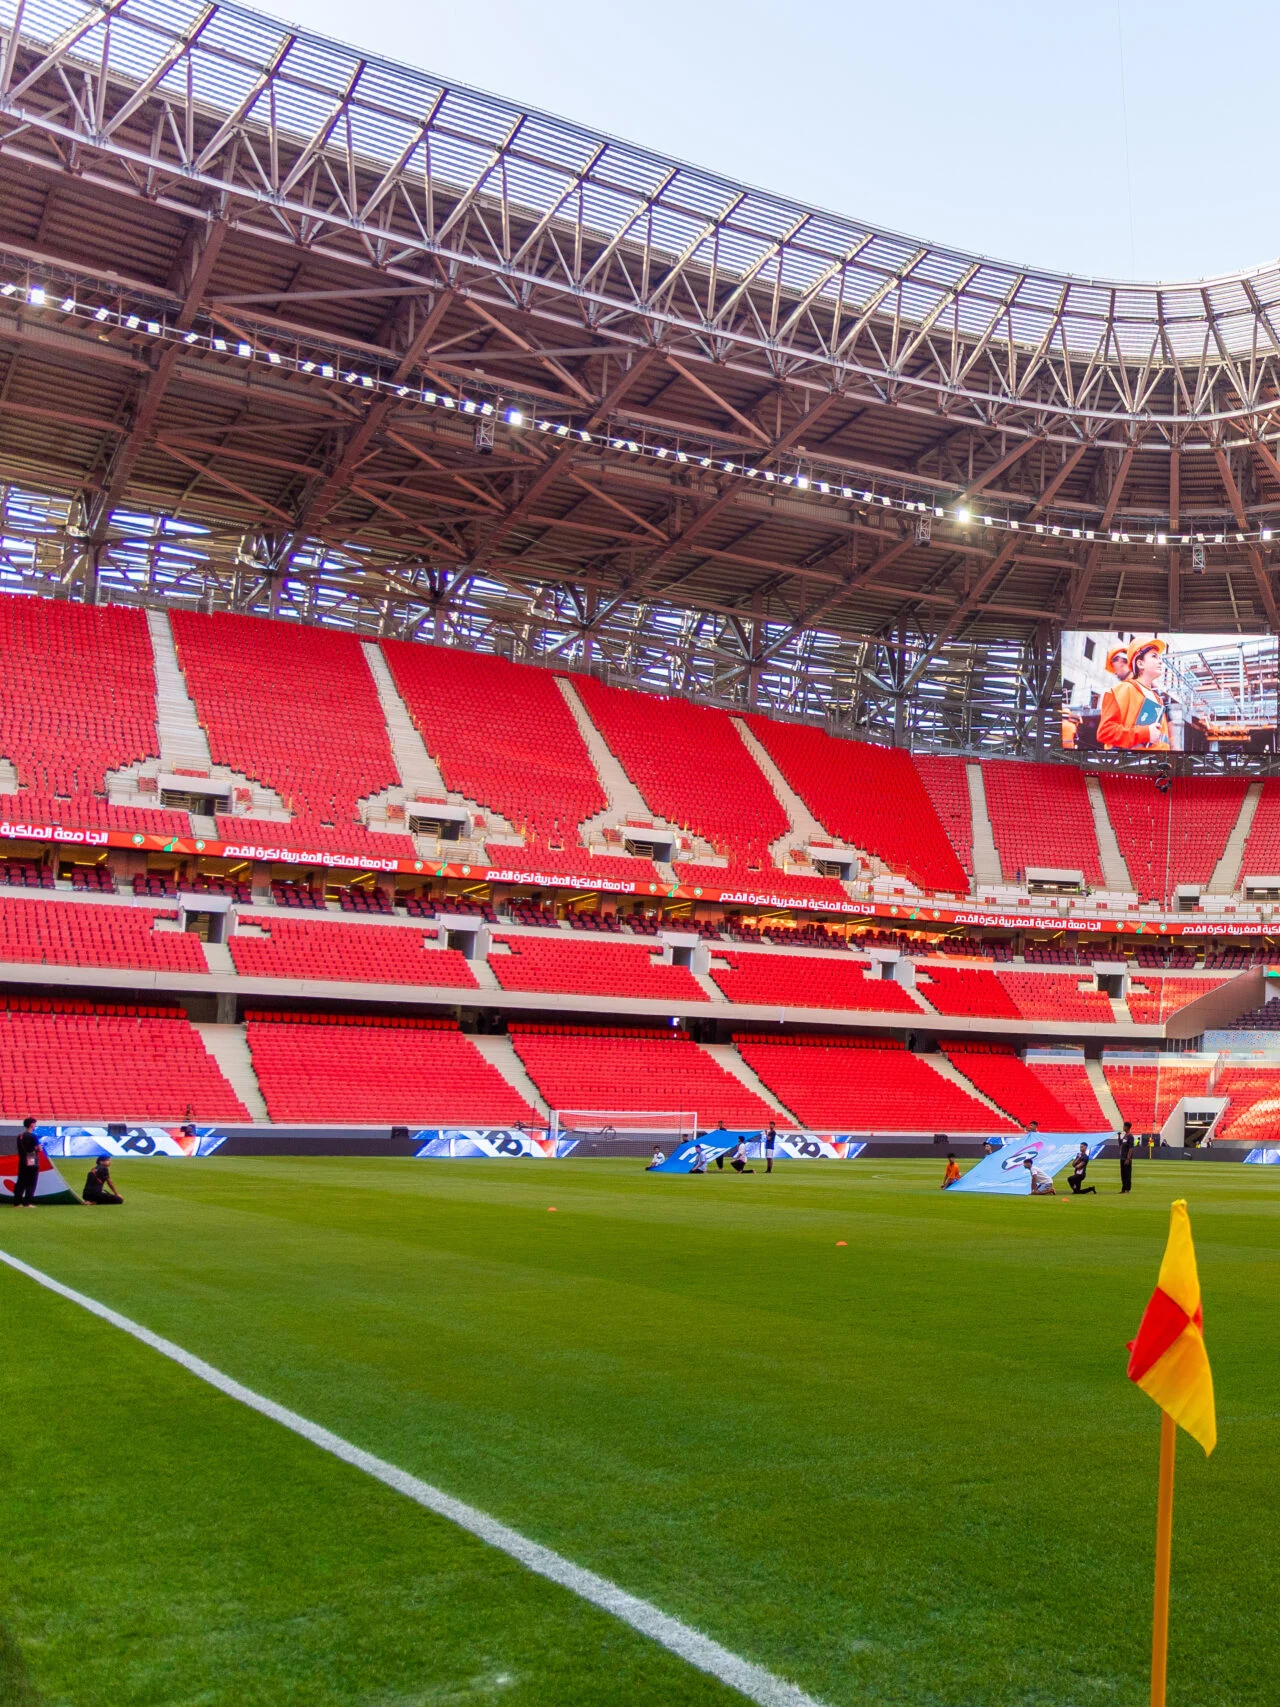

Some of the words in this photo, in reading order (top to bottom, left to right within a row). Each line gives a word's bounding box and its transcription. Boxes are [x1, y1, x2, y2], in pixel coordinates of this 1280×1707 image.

[0, 822, 52, 838] الملكية
[224, 846, 255, 857] القدم
[256, 848, 279, 861] لكرة
[281, 850, 322, 864] المغربية
[323, 853, 359, 867] الملكية
[486, 870, 512, 881] القدم
[720, 892, 747, 902] القدم
[954, 914, 978, 924] القدم
[1182, 925, 1206, 935] القدم
